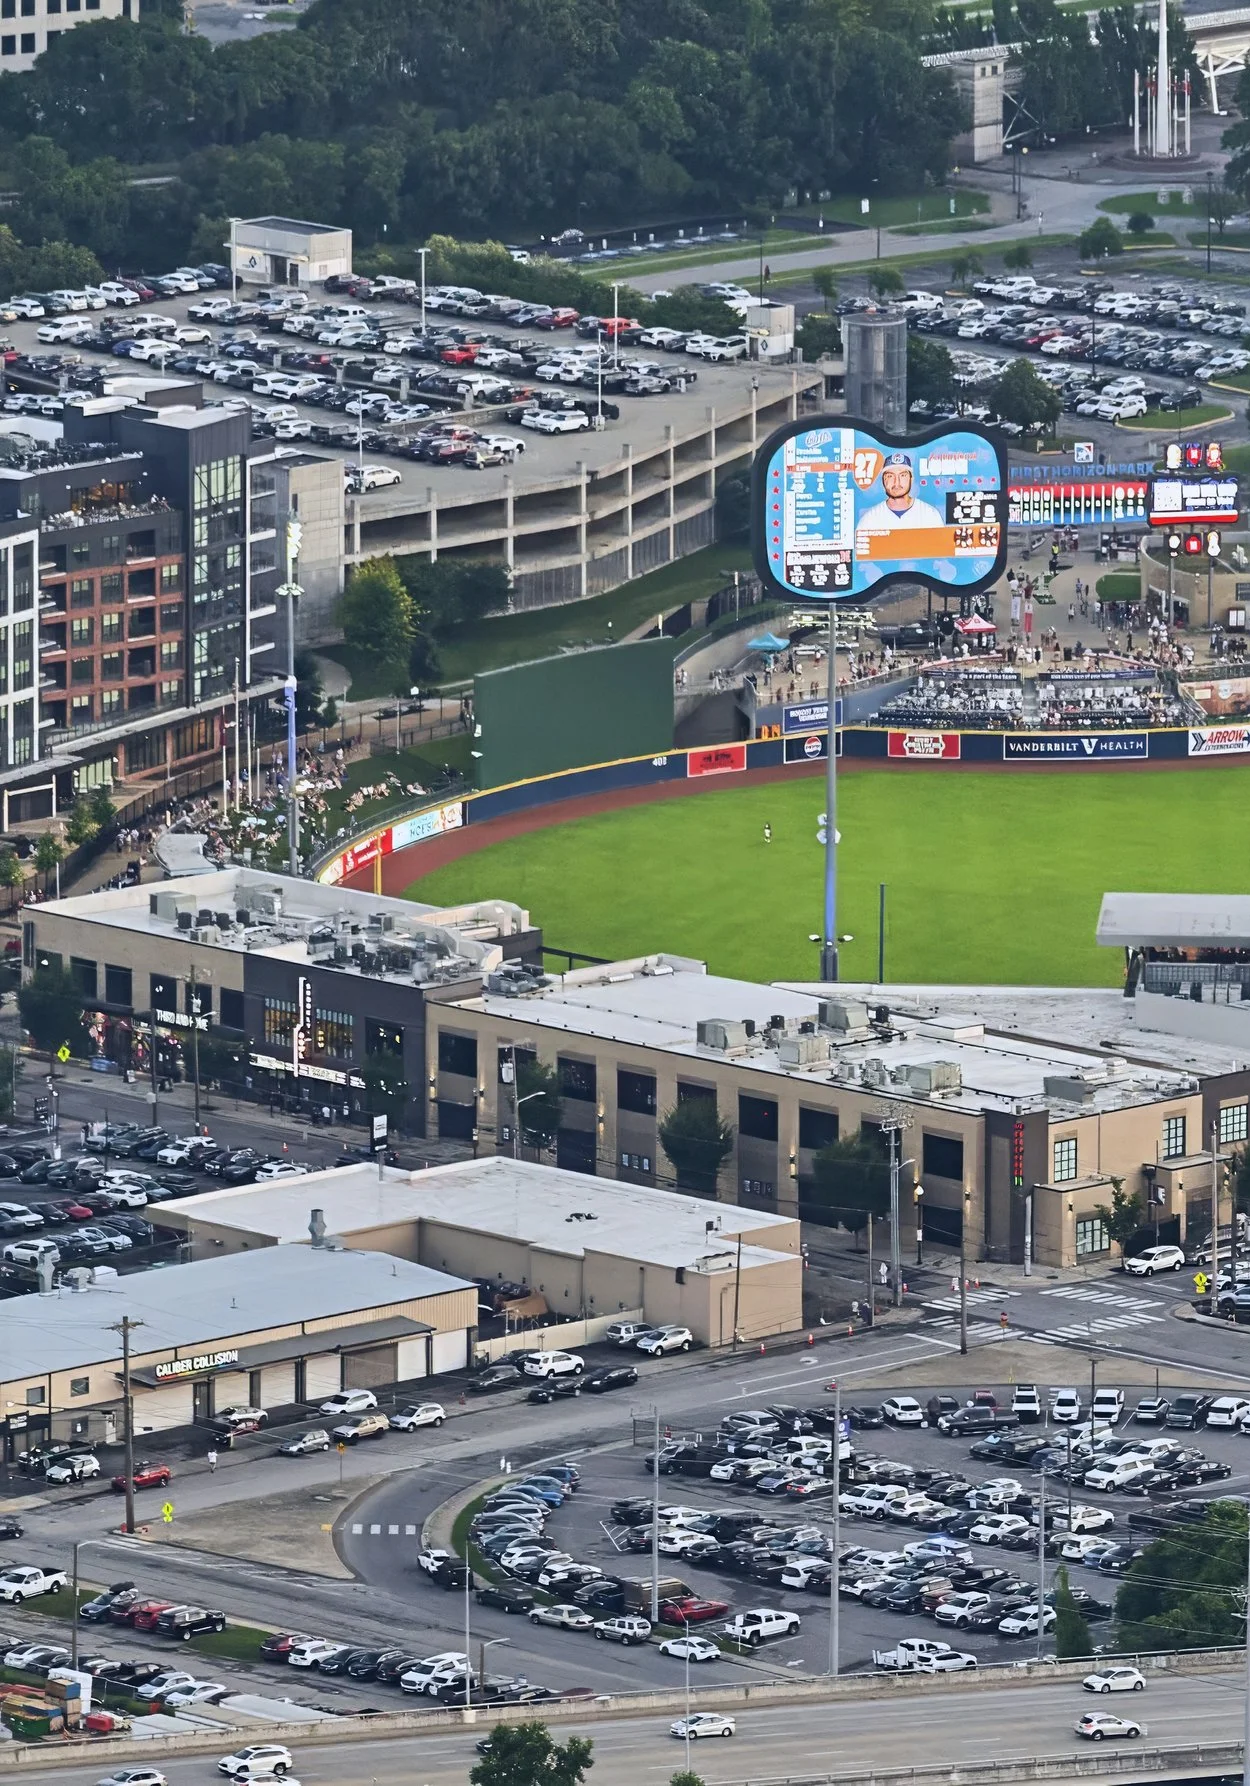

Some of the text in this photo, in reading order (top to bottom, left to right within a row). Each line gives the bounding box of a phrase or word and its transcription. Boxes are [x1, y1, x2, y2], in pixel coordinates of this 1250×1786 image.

[854, 453, 878, 478] 27
[1010, 462, 1154, 478] FIRST HORIZON PARK
[1208, 729, 1243, 743] ARROW
[1009, 743, 1078, 752] VANDERBILT
[1100, 741, 1144, 751] HEALTH
[155, 1008, 175, 1024] THIRD
[175, 1012, 189, 1027] AND
[155, 1349, 239, 1377] CALIBER COLLISION
